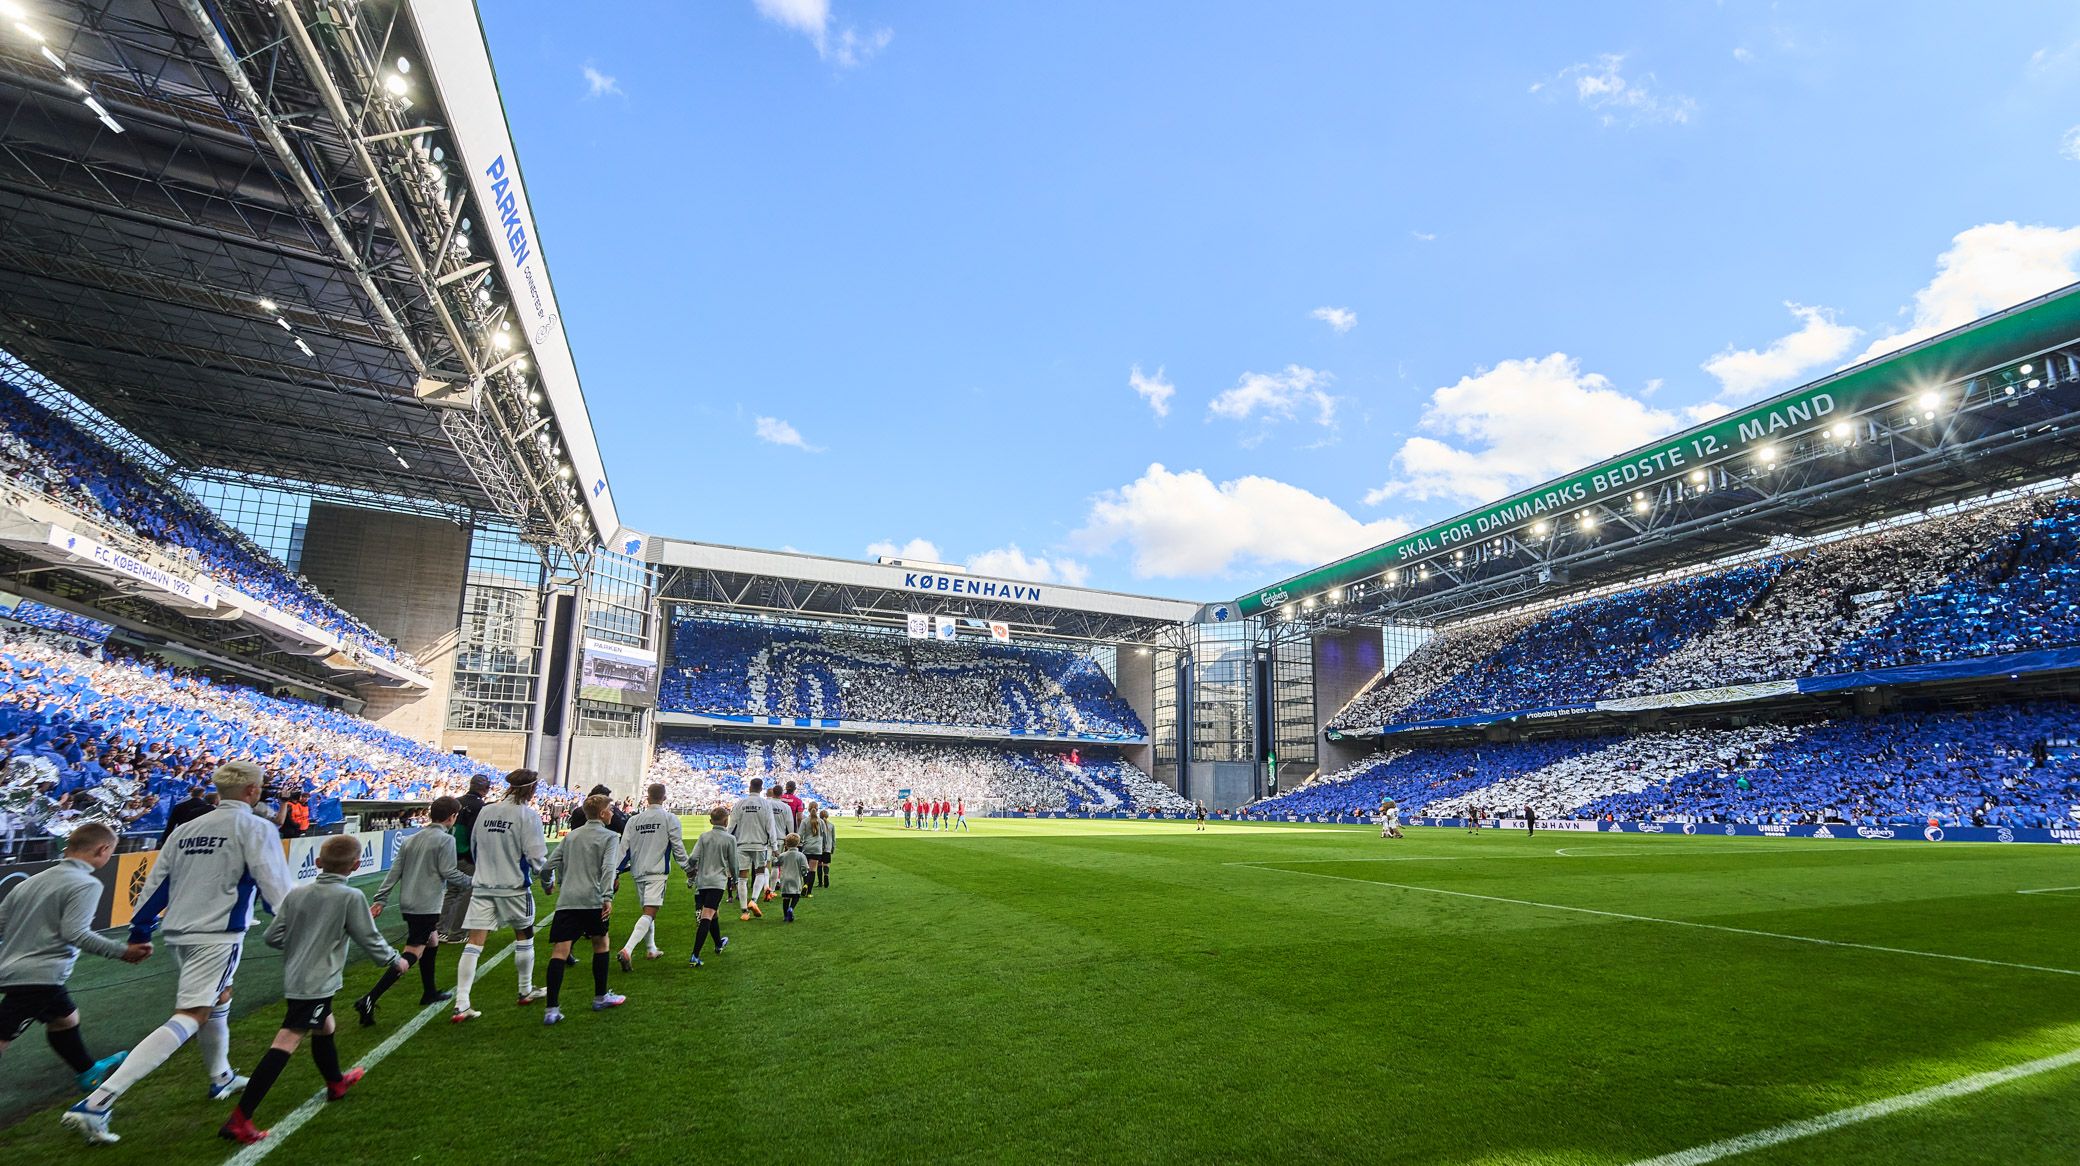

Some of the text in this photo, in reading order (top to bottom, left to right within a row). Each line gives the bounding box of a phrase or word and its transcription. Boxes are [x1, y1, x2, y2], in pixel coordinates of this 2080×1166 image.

[486, 155, 530, 268] PARKEN
[524, 266, 545, 319] CONNECTED BY
[1398, 393, 1835, 561] SKÅL FOR DANMARKS BEDSTE 12. MAND
[94, 546, 190, 595] F.C. KØBENHAVN 1992
[905, 573, 1041, 601] KØBENHAVN
[1261, 587, 1288, 607] Carlsberg
[594, 642, 623, 653] PARKEN
[484, 820, 513, 829] UNIBET
[636, 823, 661, 831] UNIBET
[1512, 821, 1580, 829] KØENHAVN
[1638, 822, 1664, 833] Carlsberg
[1857, 826, 1895, 839] Carlsberg
[178, 837, 228, 849] UNIBET
[298, 867, 317, 879] adidas
